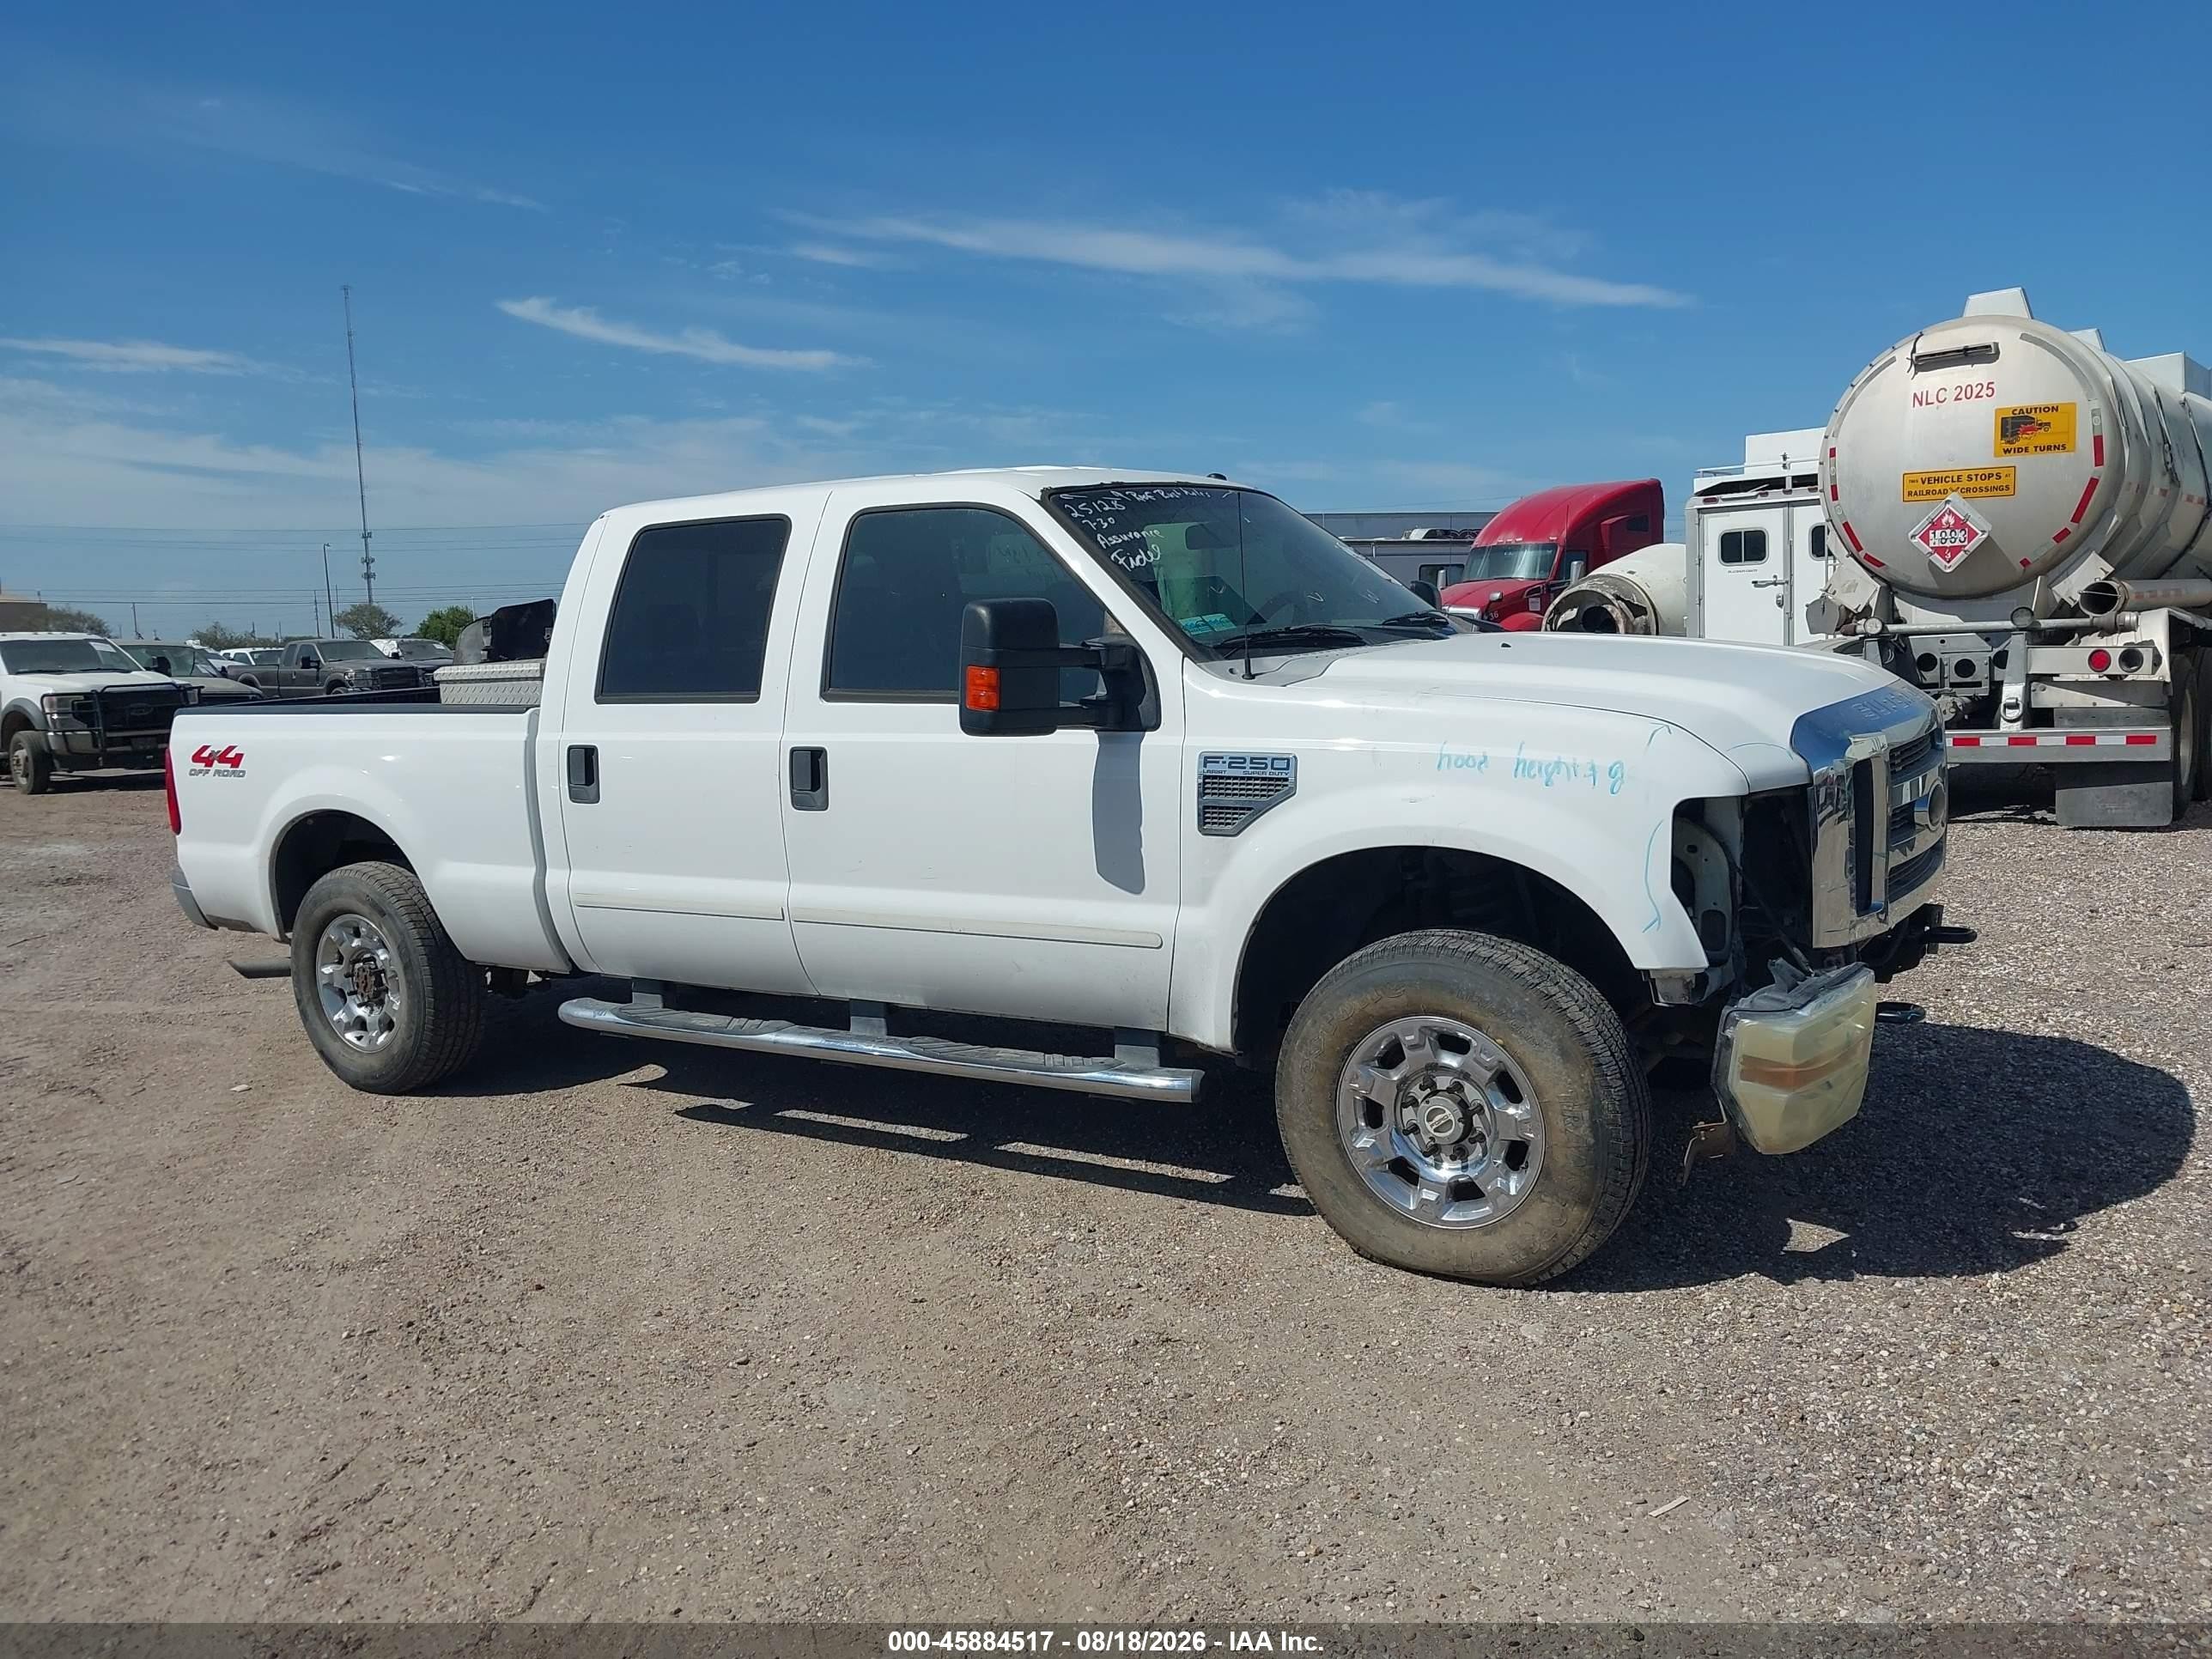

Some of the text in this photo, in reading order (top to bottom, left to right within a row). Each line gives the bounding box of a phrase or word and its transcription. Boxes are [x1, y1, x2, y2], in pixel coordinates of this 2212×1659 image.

[1912, 381, 1995, 408] NLC 2025
[2011, 405, 2059, 416] CAUTION
[2002, 443, 2067, 455] WIDE TURNS
[1920, 474, 1963, 485] VEHICLE
[1966, 471, 2002, 482] STOPS
[1907, 484, 2010, 497] RAILROAD CROSSINGS
[1203, 756, 1291, 771] F-250
[189, 769, 246, 778] OFF ROAD
